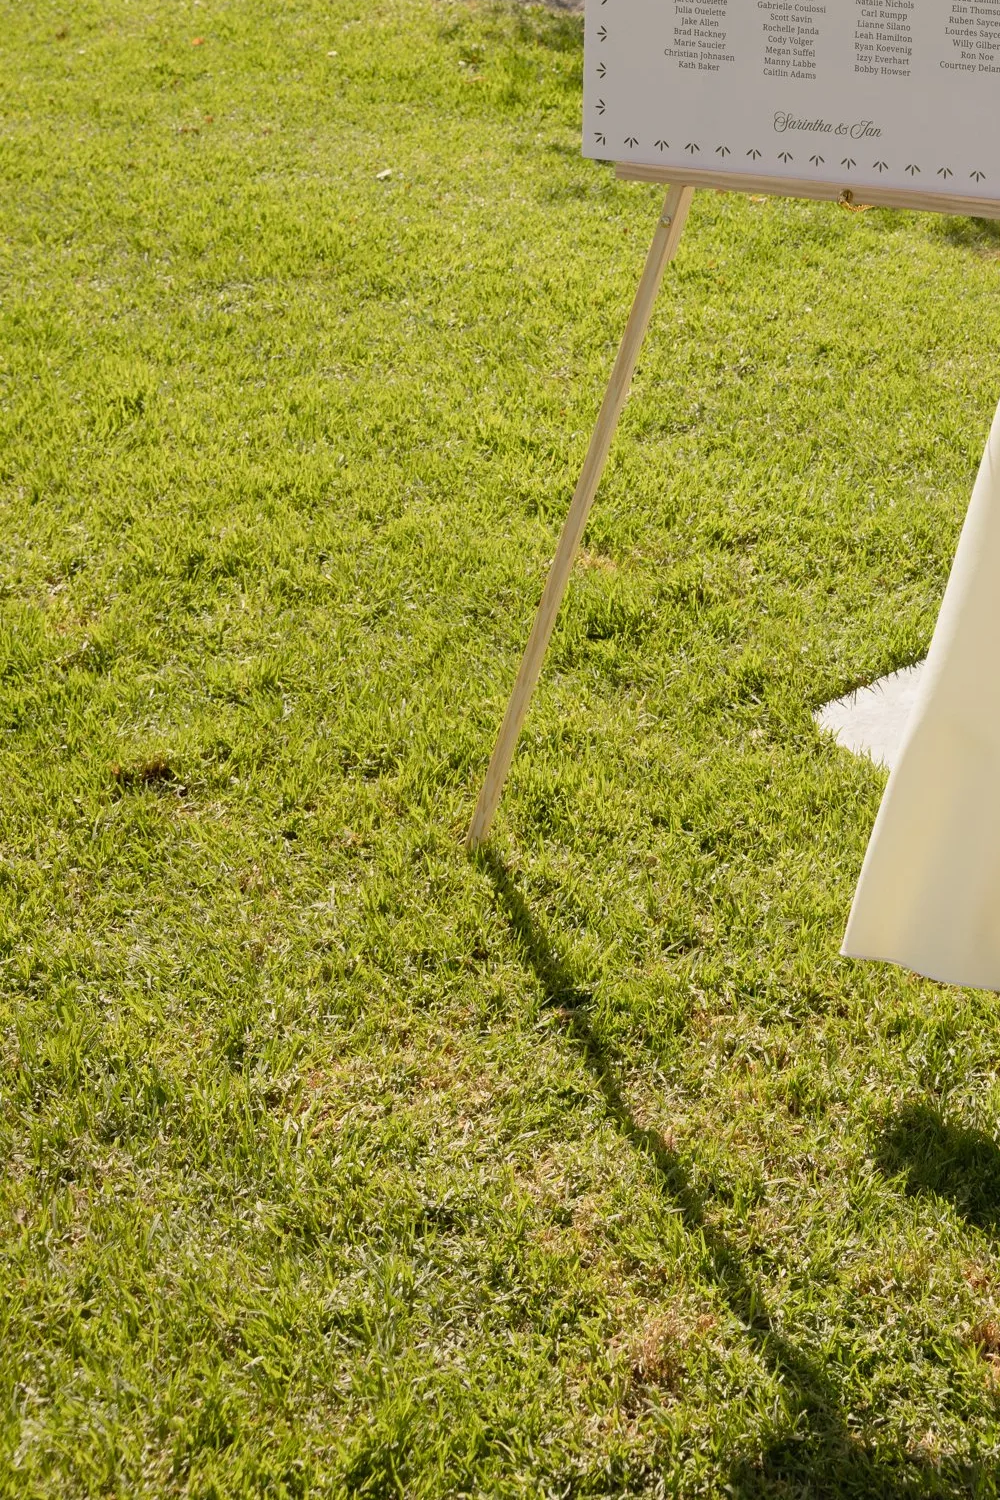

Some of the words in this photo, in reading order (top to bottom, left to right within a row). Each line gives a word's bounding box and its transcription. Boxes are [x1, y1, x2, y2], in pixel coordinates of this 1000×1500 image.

[885, 0, 914, 9] Nichols
[681, 17, 698, 26] Jake
[699, 18, 719, 27] Allen
[770, 13, 789, 22] Scott
[854, 30, 874, 40] Leah
[876, 32, 912, 43] Hamilton
[952, 39, 974, 50] Willy
[960, 51, 976, 60] Ron
[678, 60, 696, 69] Kath
[698, 62, 720, 71] Baker
[763, 68, 788, 77] Caitlin
[790, 70, 816, 79] Adams
[835, 123, 849, 135] &
